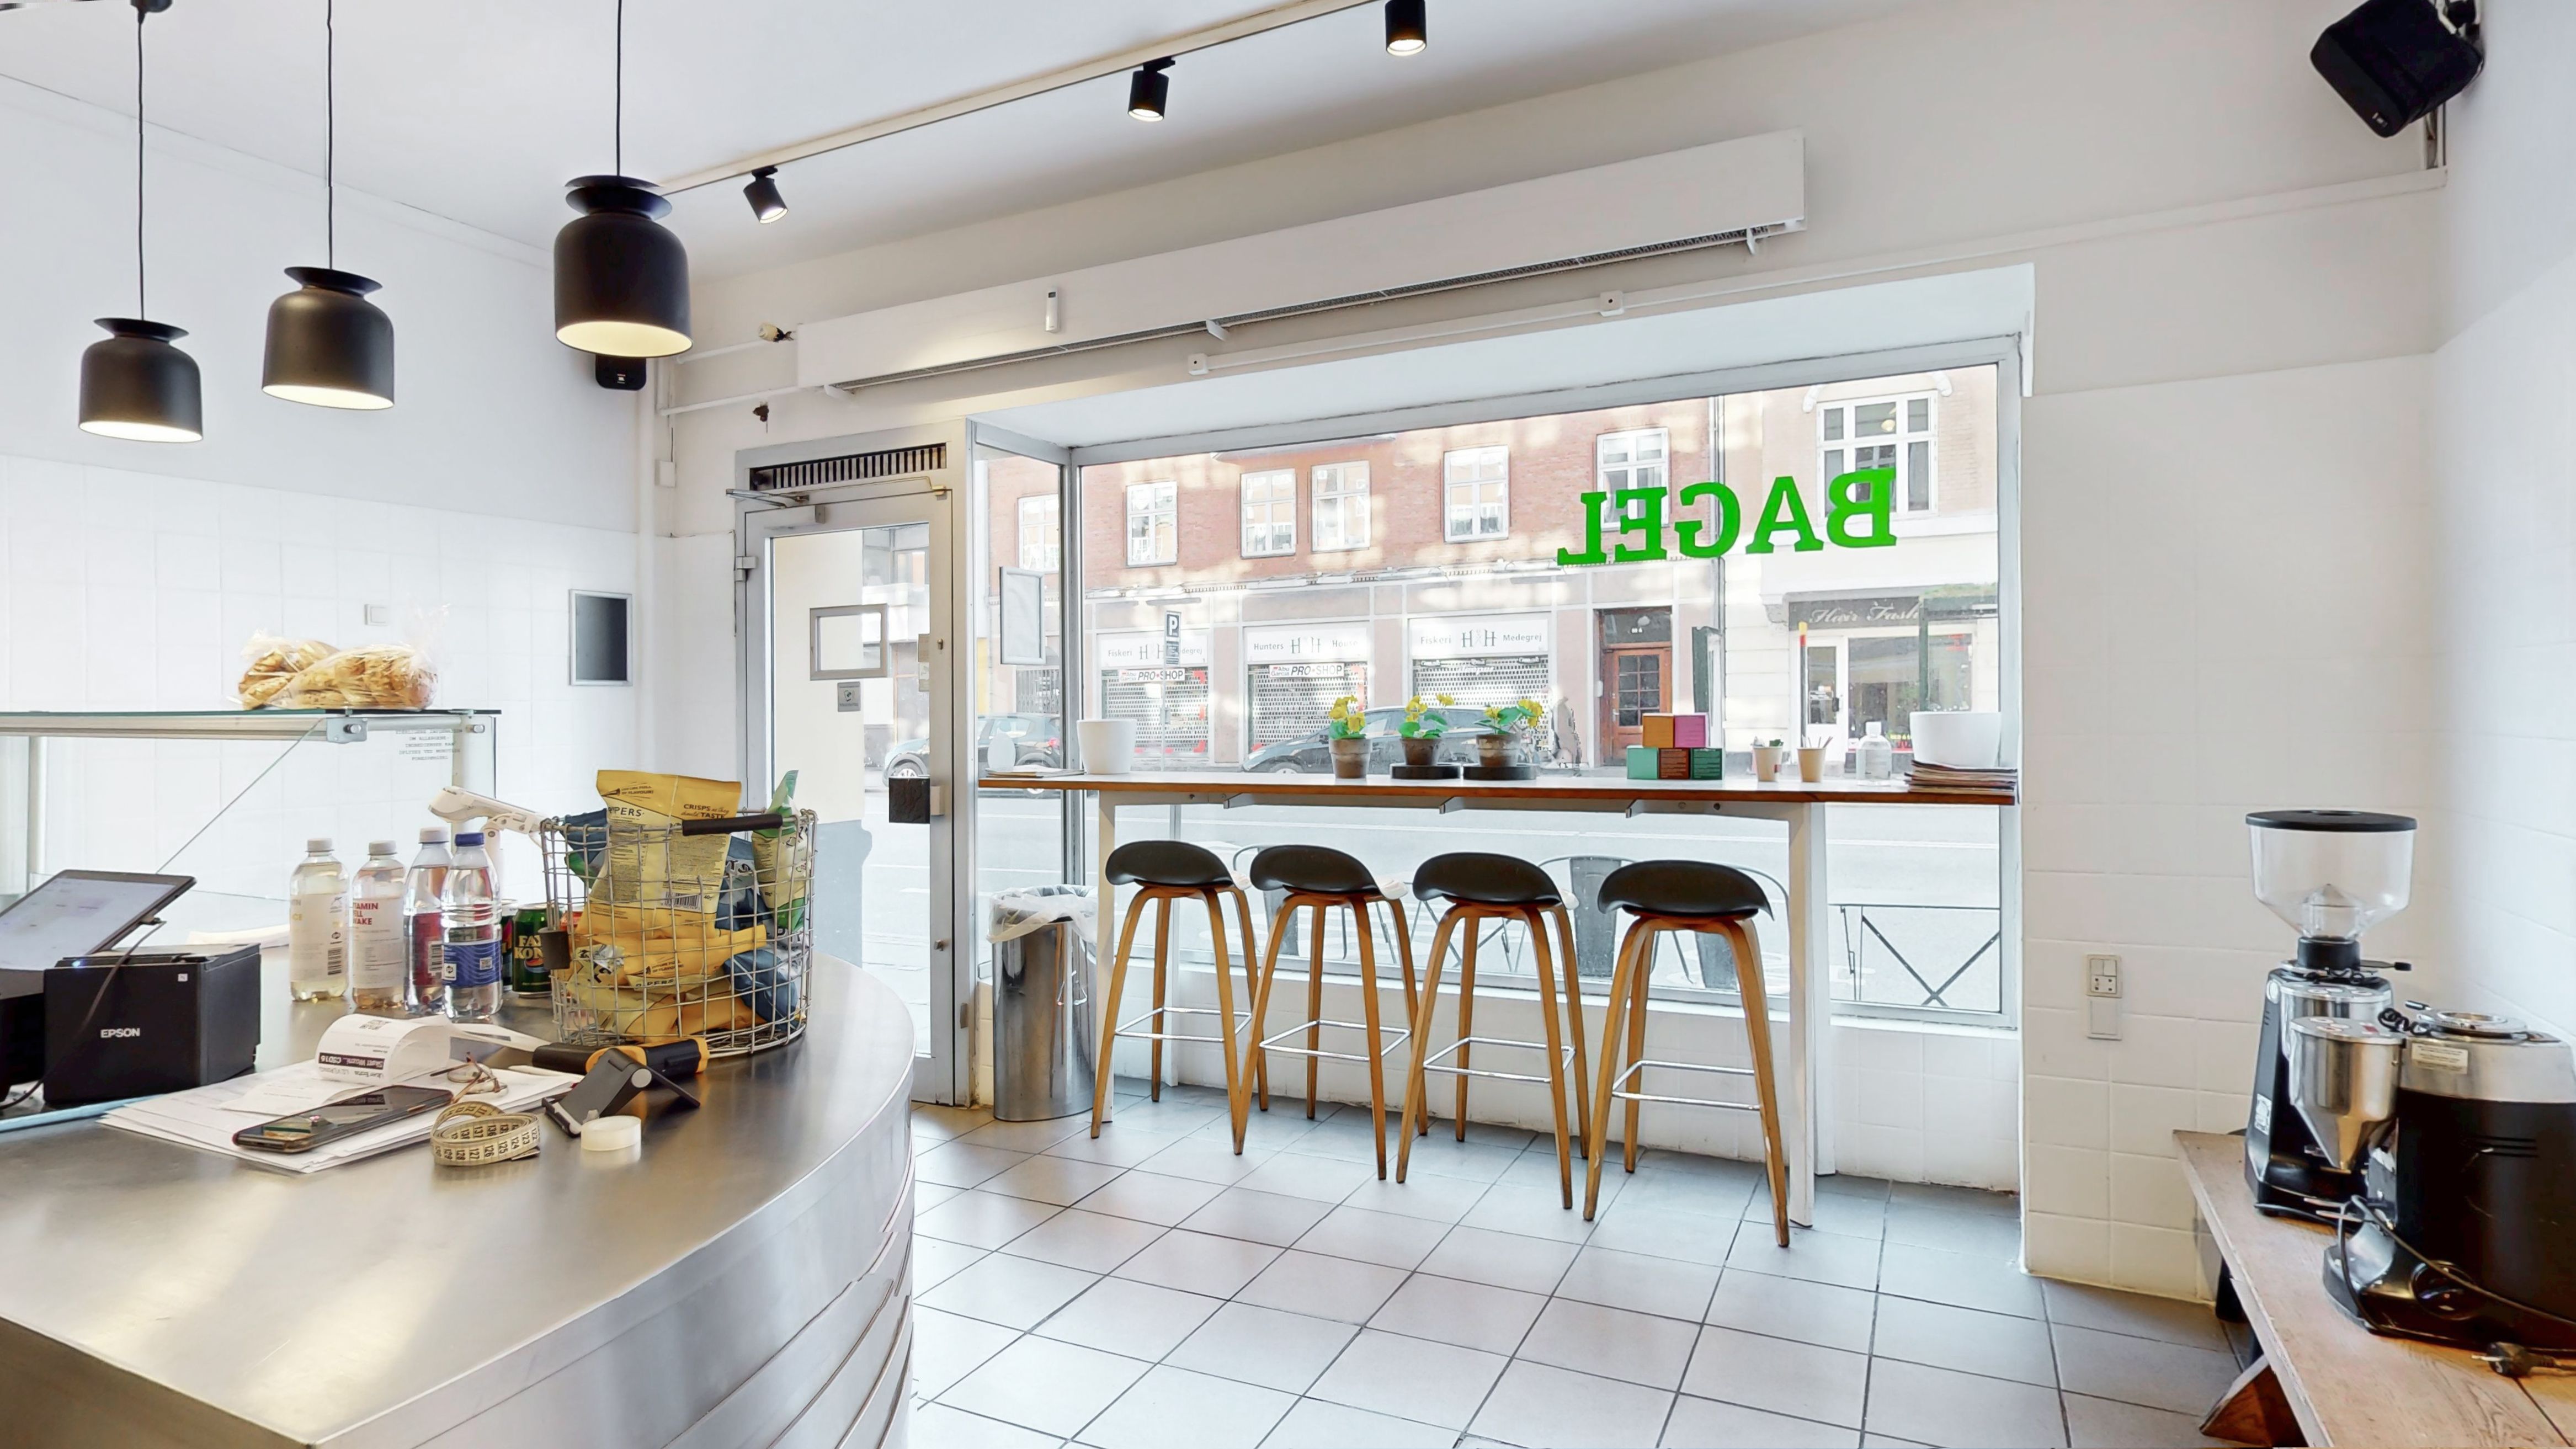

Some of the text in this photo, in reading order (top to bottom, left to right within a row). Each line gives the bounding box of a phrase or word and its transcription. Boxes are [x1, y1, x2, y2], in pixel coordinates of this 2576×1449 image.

[1809, 608, 1858, 623] Hair
[1169, 615, 1178, 636] P
[1332, 640, 1358, 648] House
[1420, 635, 1451, 644] Fiskeri
[1502, 633, 1542, 642] Medegrej
[1108, 648, 1132, 657] Fiskeri
[1137, 671, 1156, 681] PRO
[1291, 666, 1311, 676] PRO
[1316, 665, 1342, 675] SHOP
[514, 947, 544, 959] KON
[100, 1028, 141, 1038] EPSON
[474, 1126, 483, 1139] 137
[499, 1141, 508, 1154] 125
[512, 1137, 520, 1149] 124
[456, 1149, 466, 1161] 128
[470, 1148, 480, 1160] 127
[485, 1145, 494, 1158] 126
